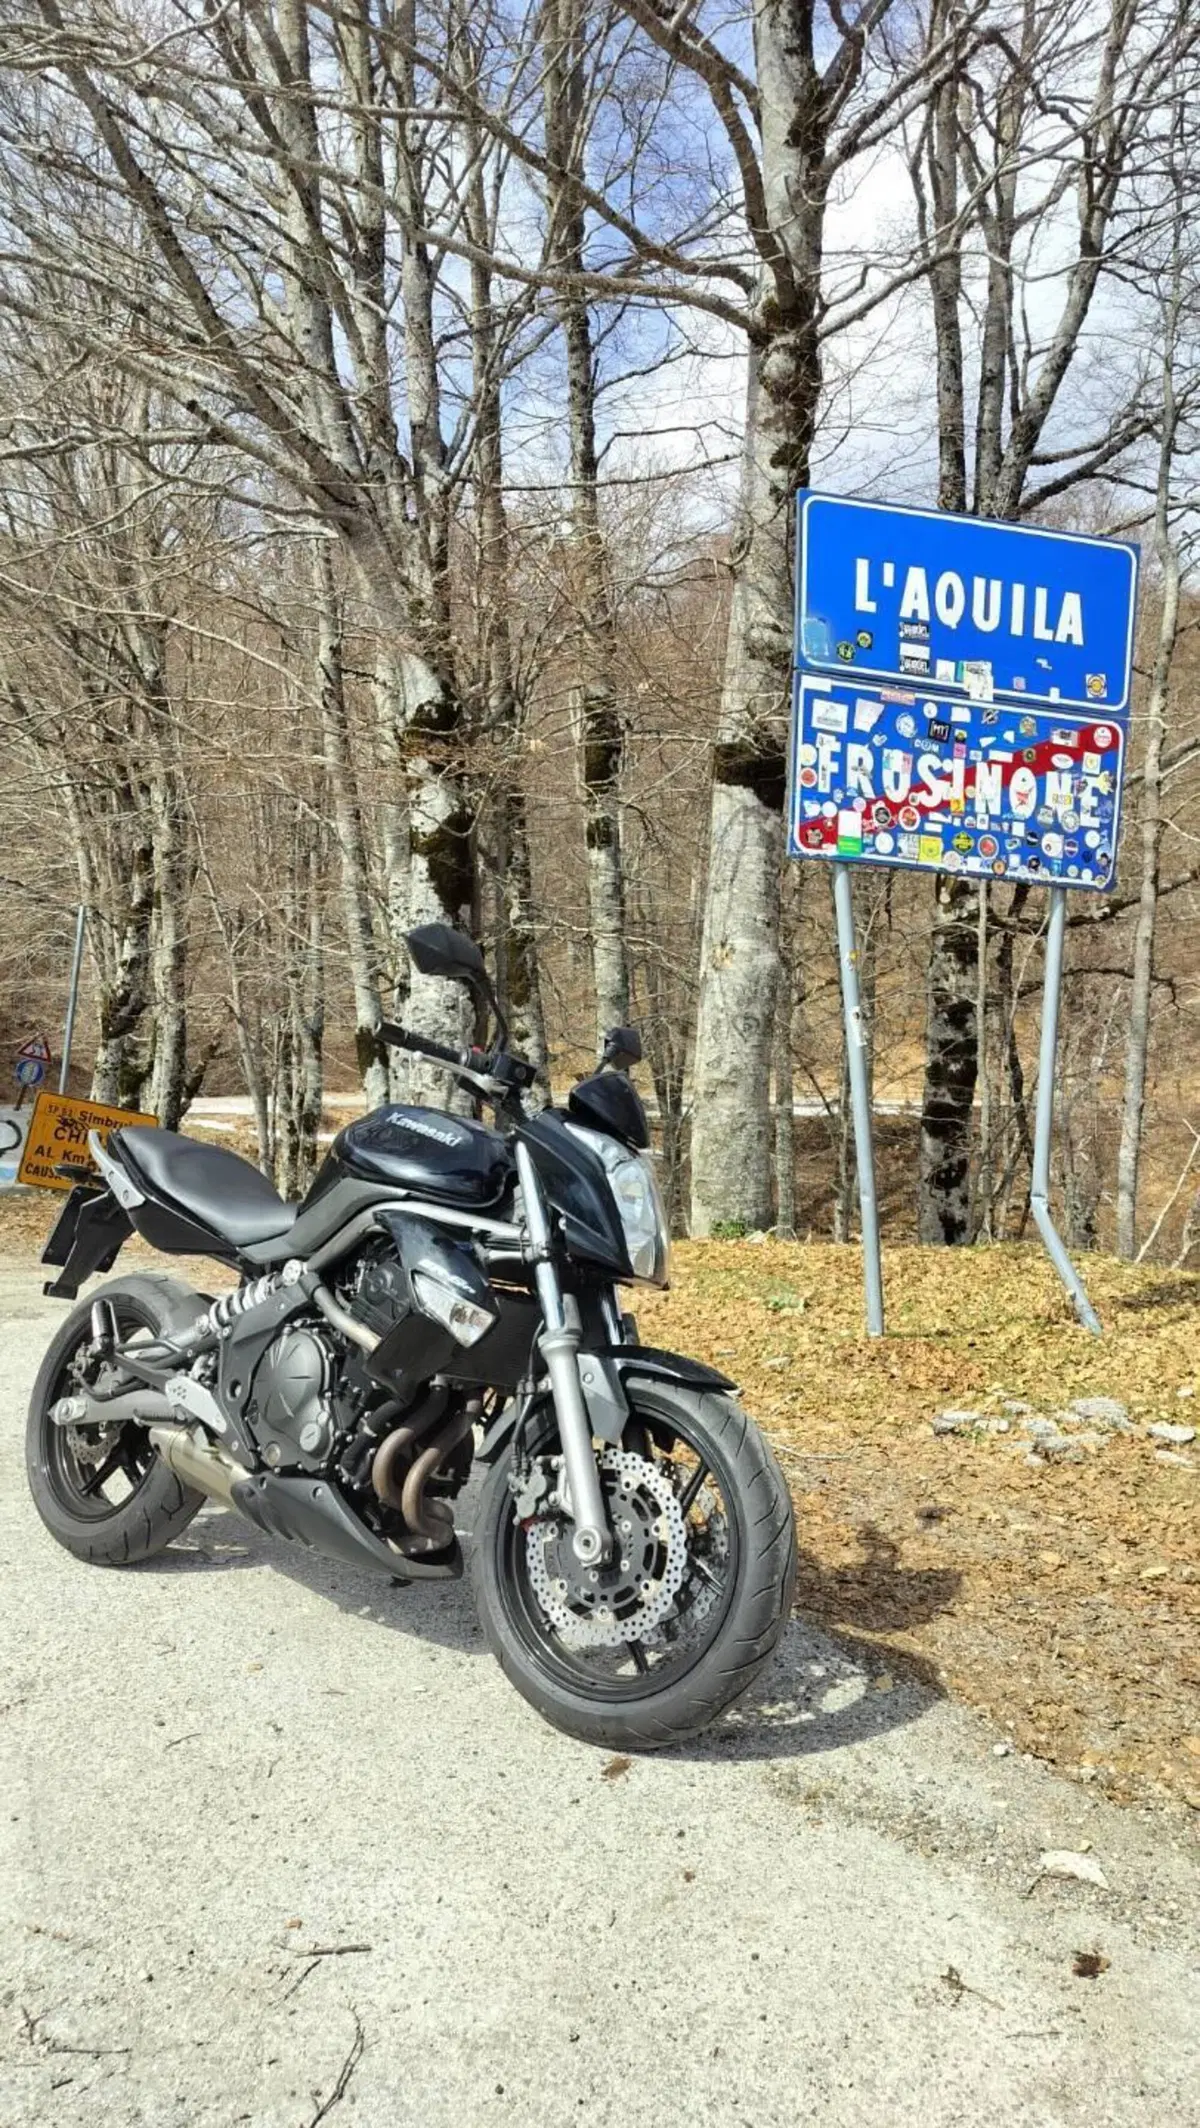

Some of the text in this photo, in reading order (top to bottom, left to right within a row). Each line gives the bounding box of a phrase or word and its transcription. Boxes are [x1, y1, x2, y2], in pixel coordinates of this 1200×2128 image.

[855, 557, 1085, 646] L'AQUILA
[54, 1126, 89, 1145] CHI
[385, 1111, 463, 1148] Kawasaki
[35, 1145, 54, 1159] AL
[62, 1149, 85, 1165] Km
